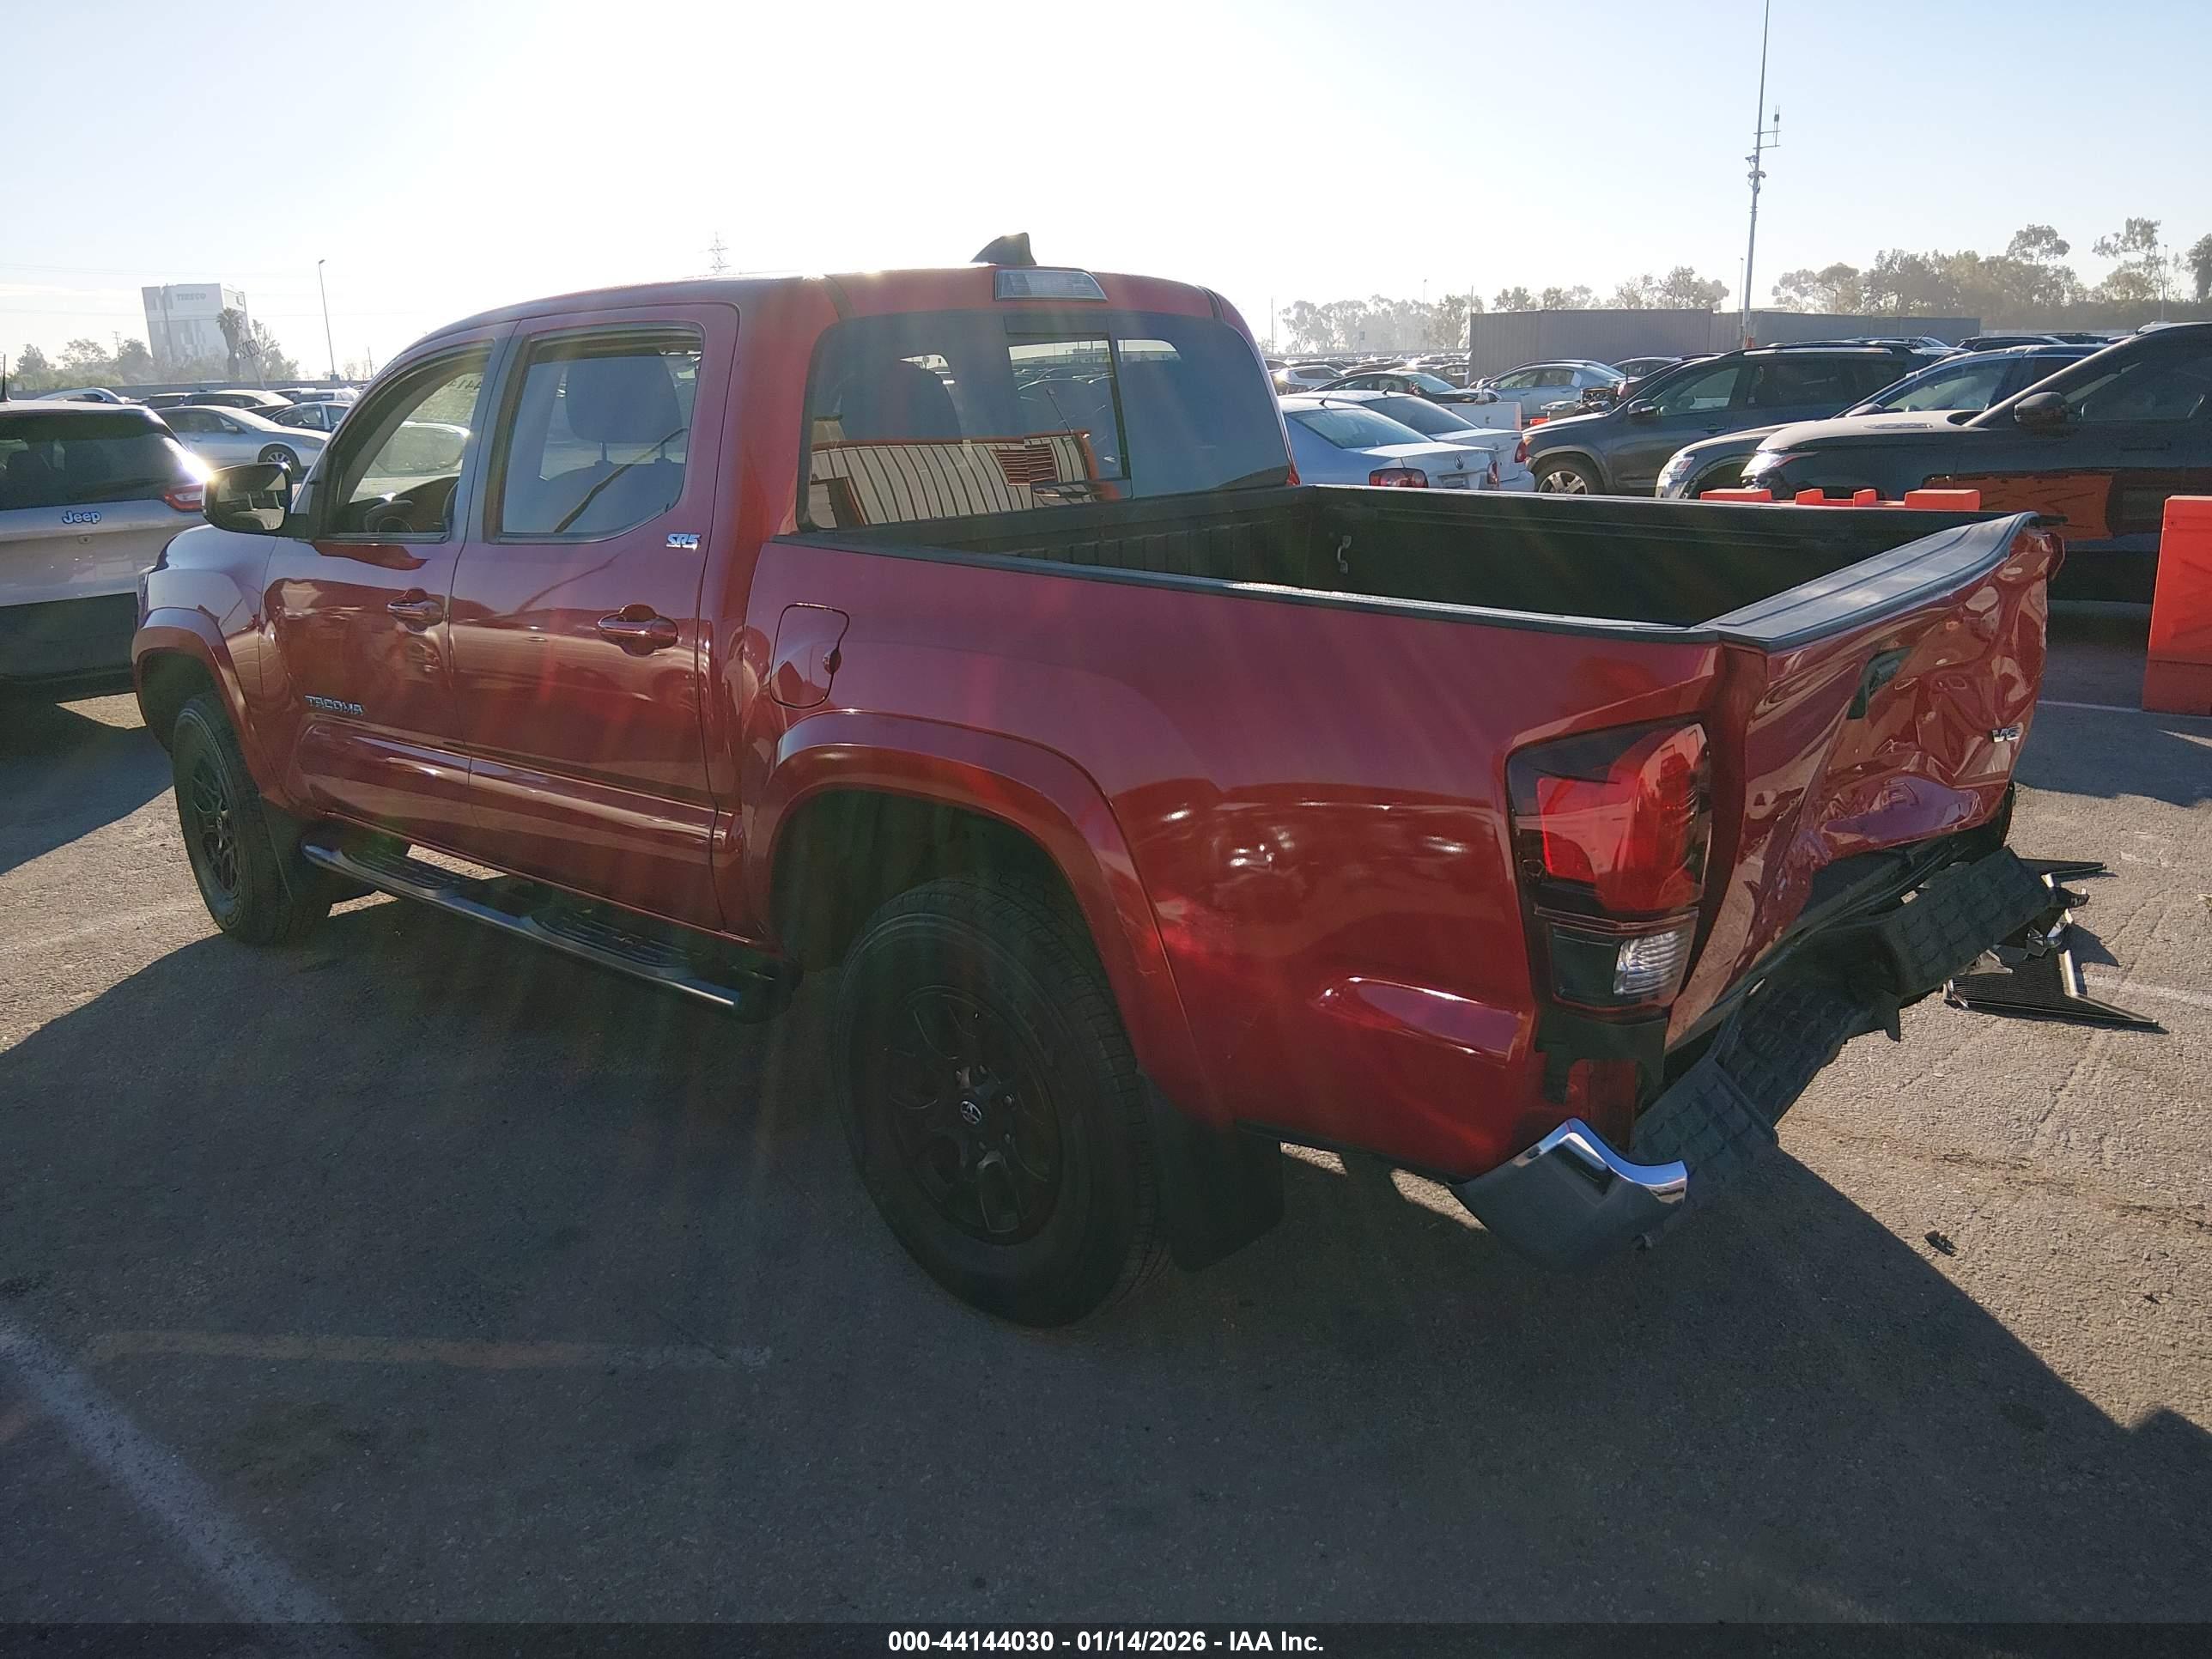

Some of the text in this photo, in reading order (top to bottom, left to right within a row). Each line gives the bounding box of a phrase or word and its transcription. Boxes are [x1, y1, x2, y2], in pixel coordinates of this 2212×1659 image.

[62, 510, 101, 524] Jeep
[666, 533, 702, 550] SR5
[304, 695, 364, 715] TACOMA
